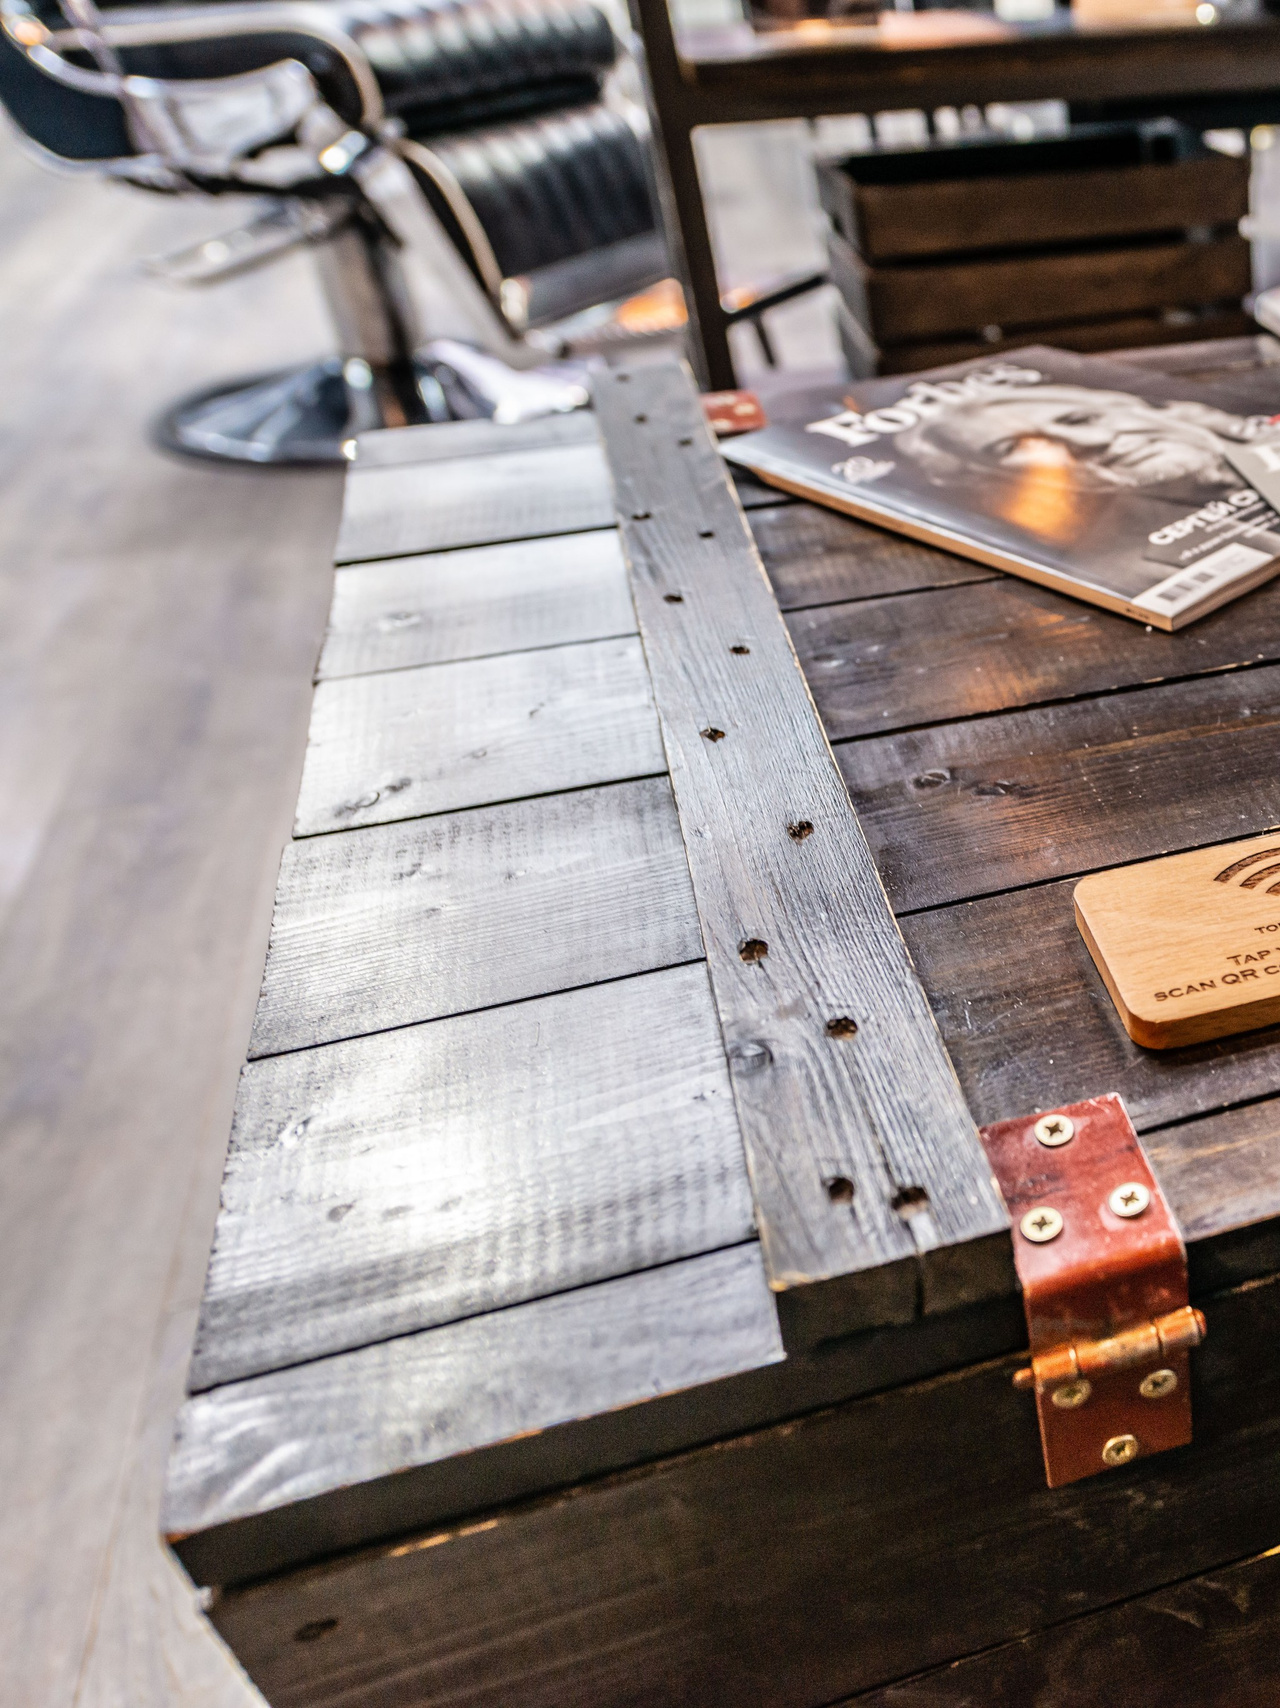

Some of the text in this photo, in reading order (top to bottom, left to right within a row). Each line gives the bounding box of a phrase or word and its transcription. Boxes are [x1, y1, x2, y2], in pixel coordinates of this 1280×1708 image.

[1226, 949, 1272, 966] TAP
[1153, 979, 1217, 1002] SCAN
[1221, 968, 1260, 984] QR
